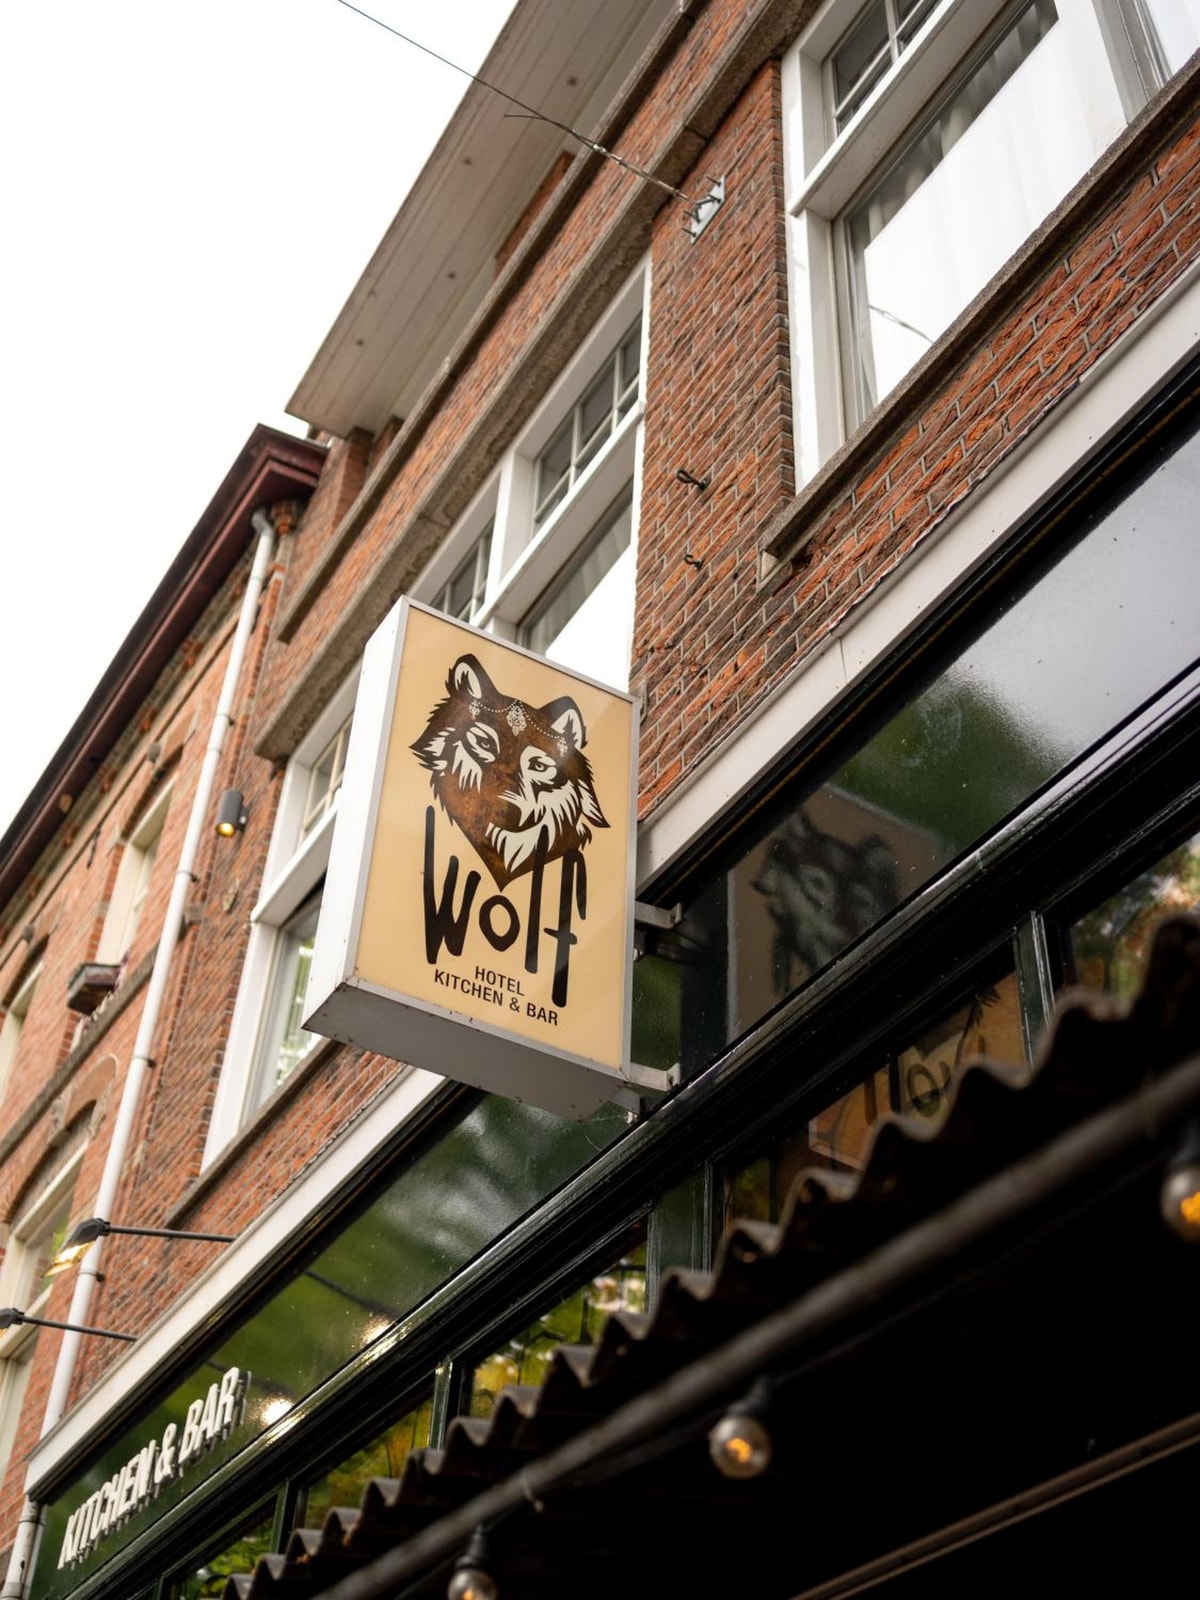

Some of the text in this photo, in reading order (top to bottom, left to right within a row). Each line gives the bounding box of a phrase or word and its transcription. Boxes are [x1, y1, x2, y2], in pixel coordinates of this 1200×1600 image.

[423, 805, 587, 1008] Wolf
[434, 969, 558, 1026] KITCHEN & BAR
[475, 966, 525, 996] HOTEL
[57, 1366, 242, 1570] KITCHEN & BAR
